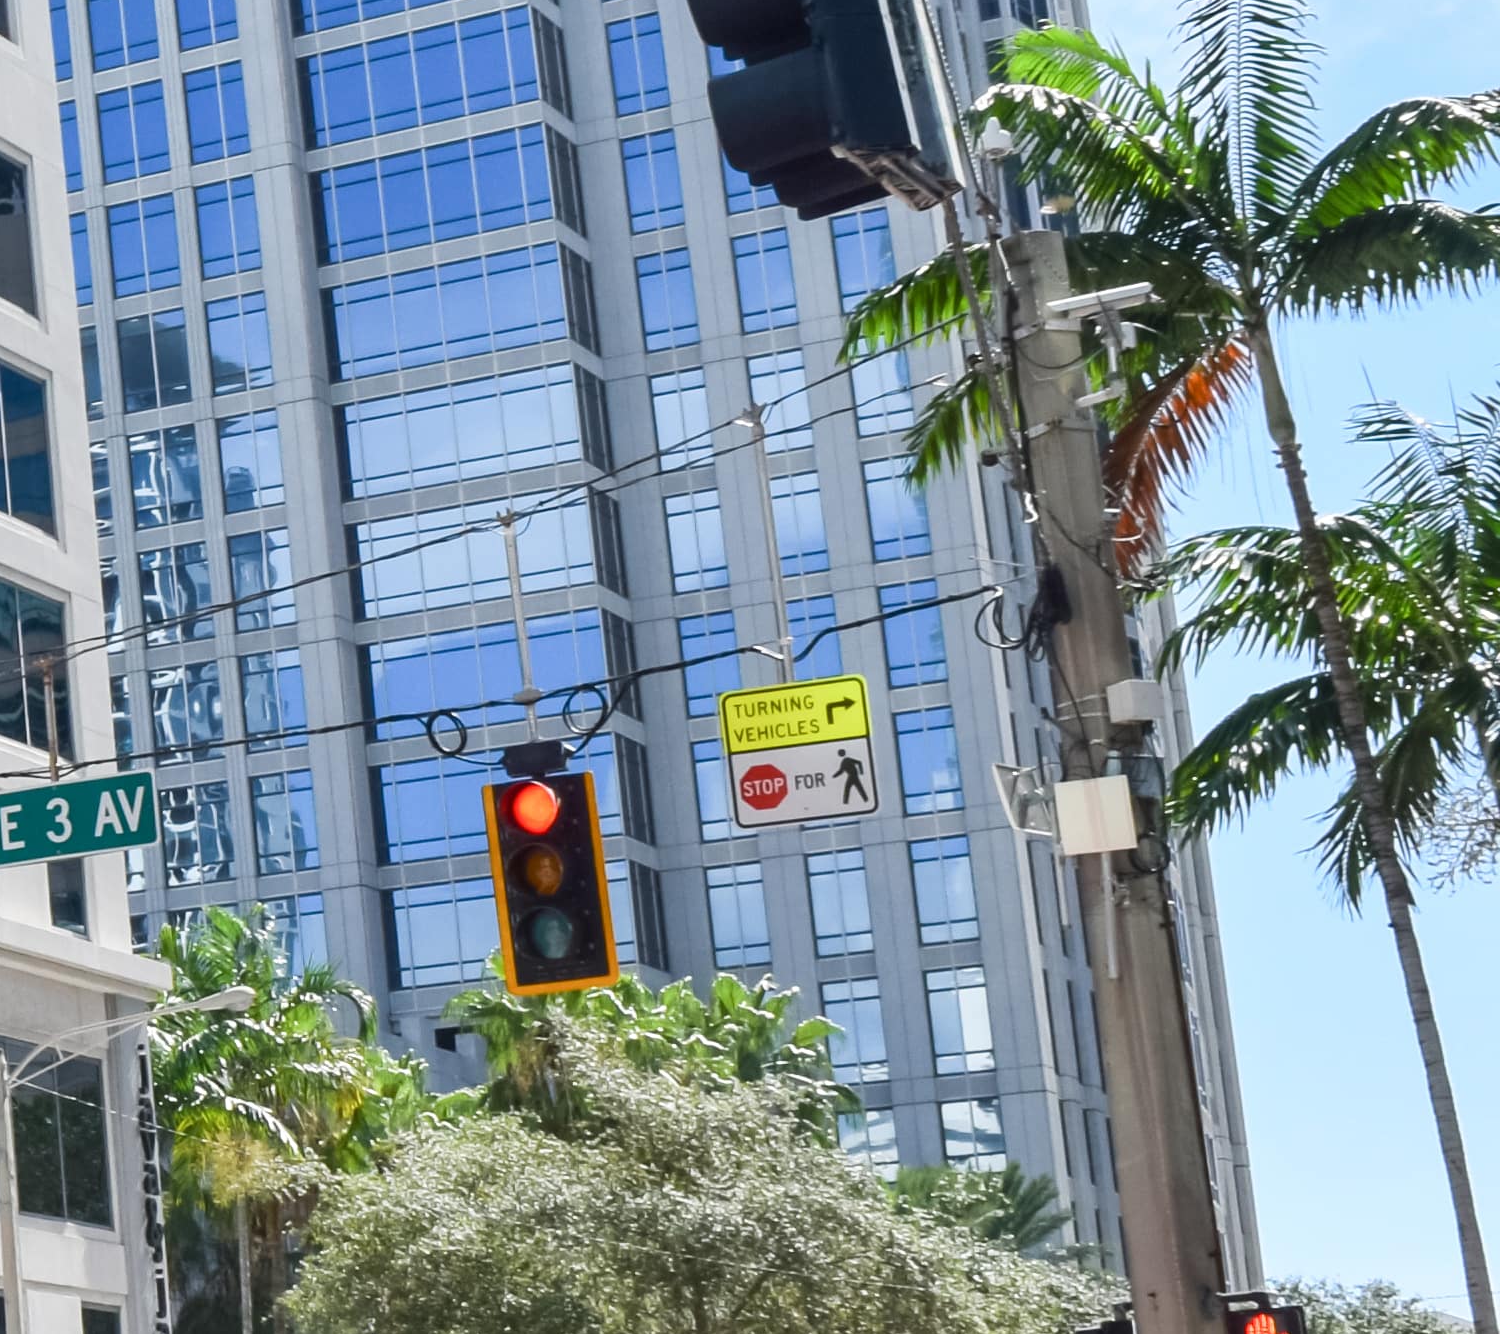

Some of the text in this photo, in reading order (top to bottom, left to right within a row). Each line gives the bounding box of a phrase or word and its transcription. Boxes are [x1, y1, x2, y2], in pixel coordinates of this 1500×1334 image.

[733, 695, 815, 719] TURNING
[734, 719, 820, 742] VEHICLES
[743, 773, 826, 797] STOP FOR
[46, 798, 72, 843] 3
[95, 786, 145, 837] AV
